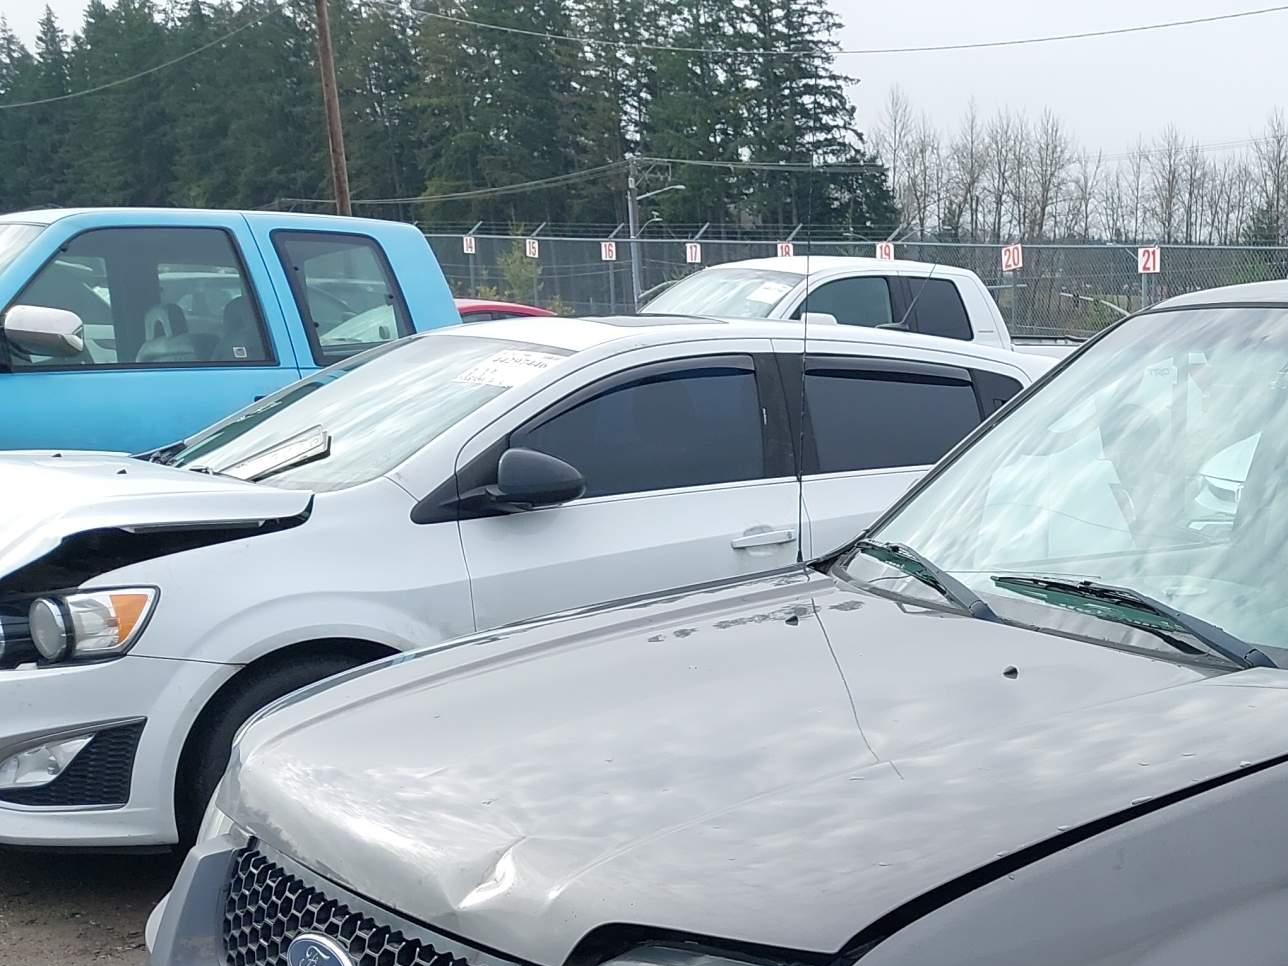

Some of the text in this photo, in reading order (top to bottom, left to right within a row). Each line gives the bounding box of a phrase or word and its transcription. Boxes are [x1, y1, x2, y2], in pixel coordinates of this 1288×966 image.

[465, 238, 474, 253] 14
[528, 240, 537, 256] 15
[604, 243, 614, 259] 16
[689, 244, 698, 261] 17
[879, 244, 891, 261] 19
[1004, 249, 1020, 269] 20
[1141, 252, 1157, 271] 21
